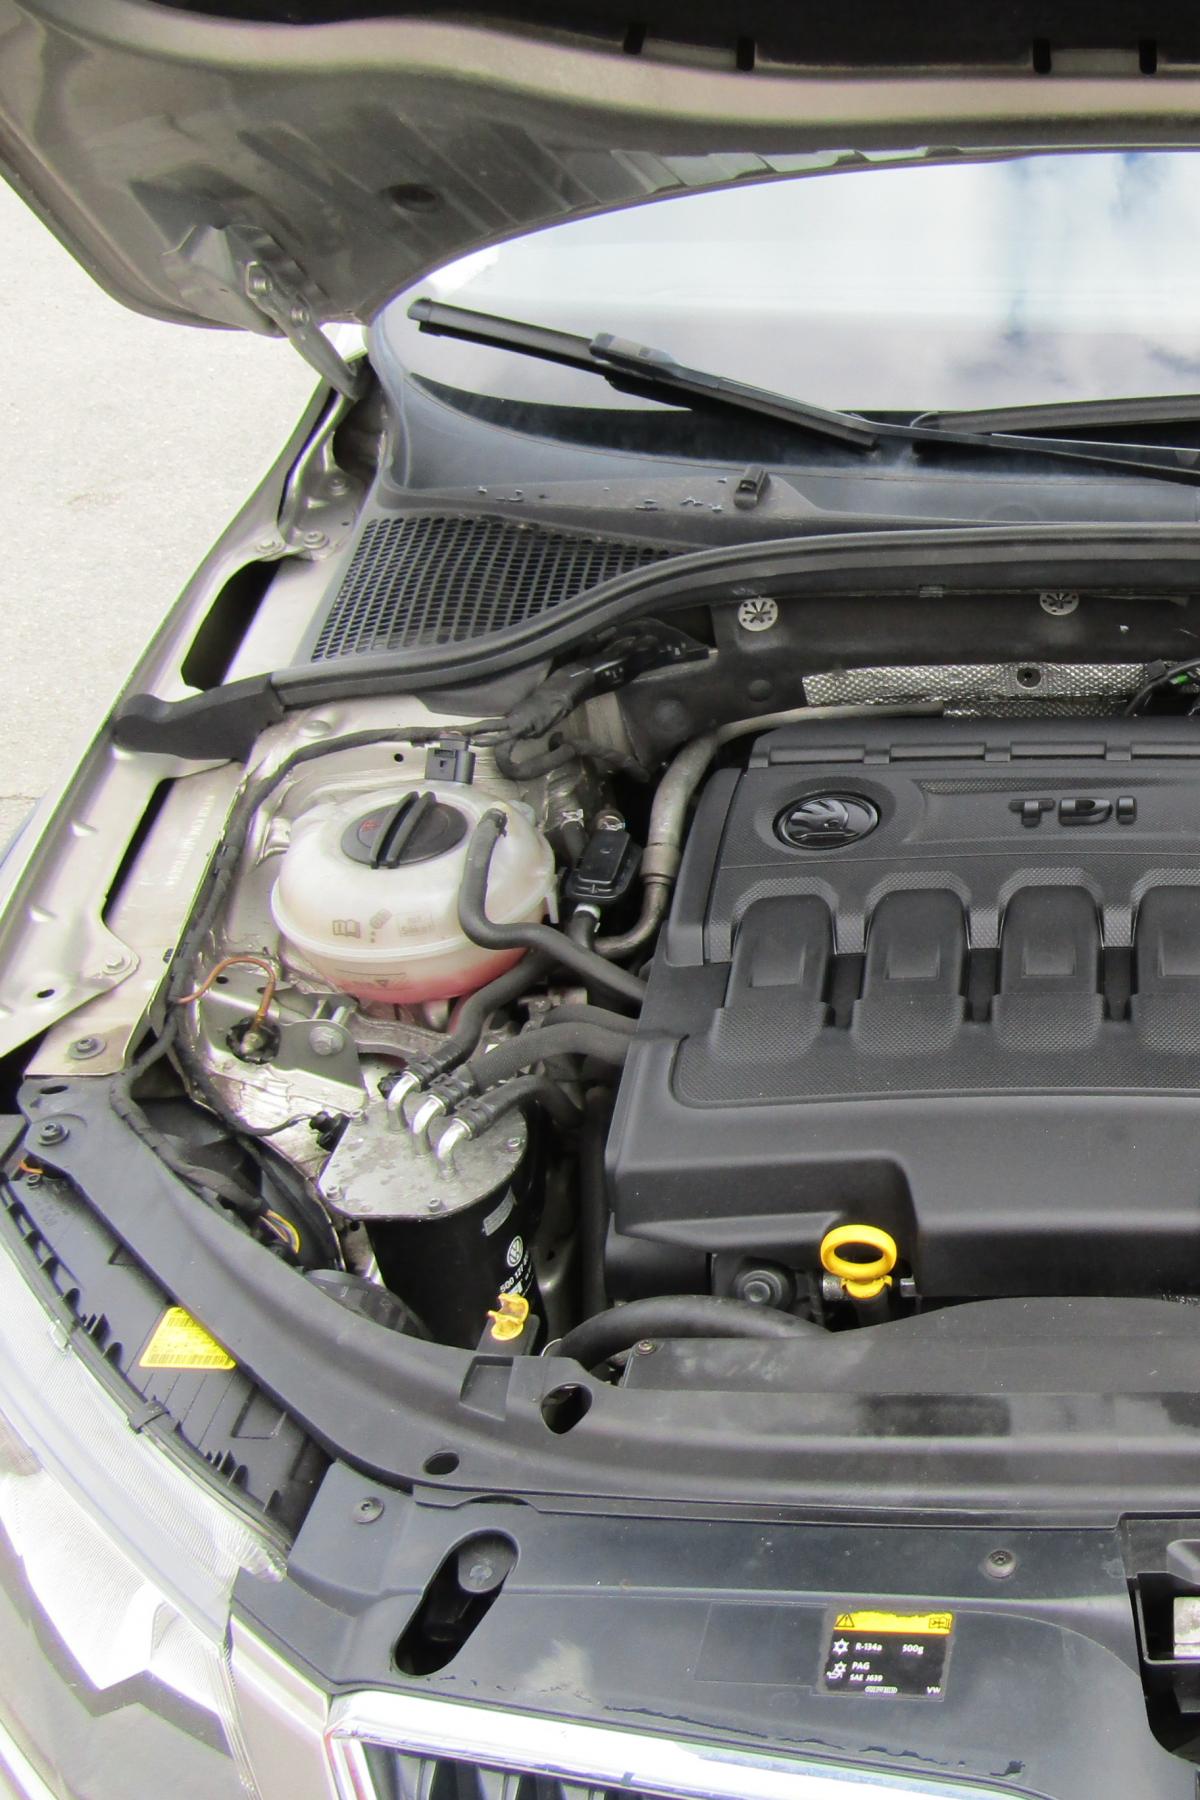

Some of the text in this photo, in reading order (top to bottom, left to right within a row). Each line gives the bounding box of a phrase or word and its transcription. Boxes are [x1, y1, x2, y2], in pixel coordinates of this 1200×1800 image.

[1008, 795, 1137, 828] TDI
[855, 1643, 924, 1654] R-134a 500g
[852, 1661, 870, 1670] PAG
[850, 1673, 883, 1682] SAE J639
[927, 1686, 941, 1694] VW
